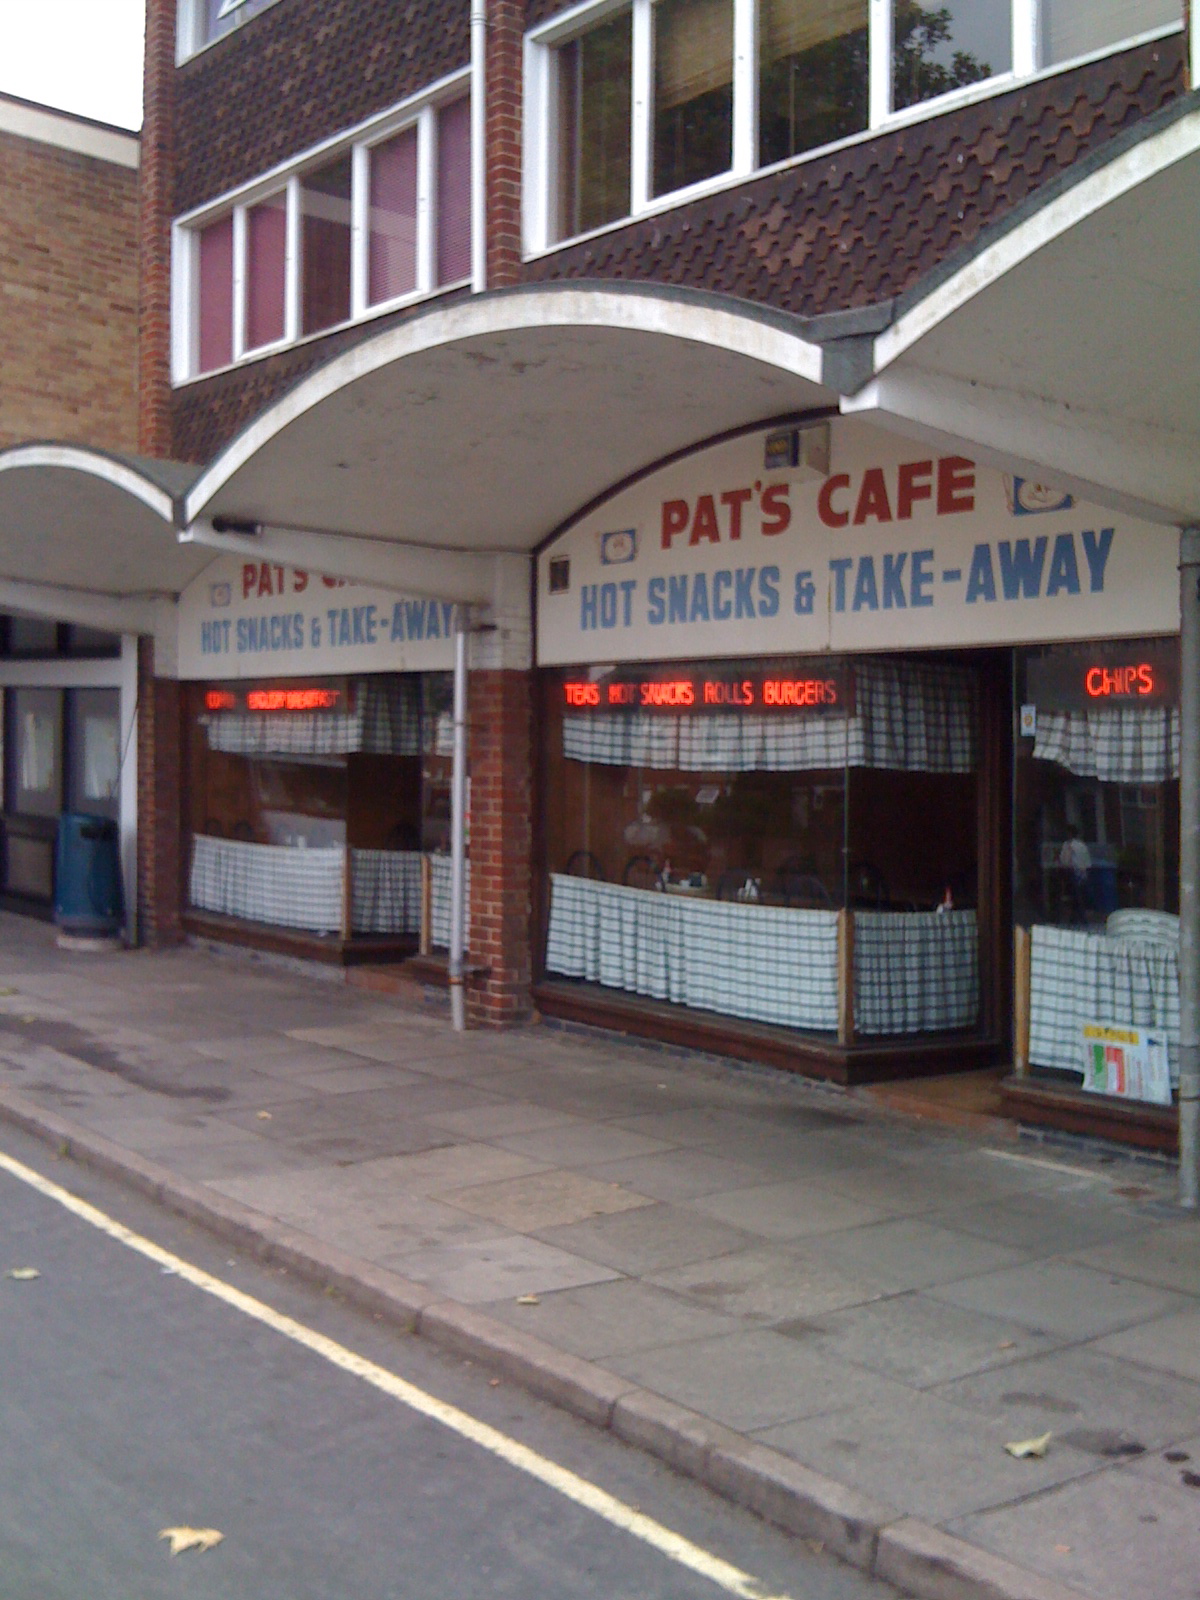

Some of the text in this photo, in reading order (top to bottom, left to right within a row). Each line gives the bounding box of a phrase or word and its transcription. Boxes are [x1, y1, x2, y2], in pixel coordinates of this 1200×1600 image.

[661, 456, 975, 549] PAT'S CAFE
[242, 562, 309, 598] PATS
[580, 527, 1115, 631] HOT SNACKS & TAKE-AWAY
[201, 601, 454, 655] HOT SNACKS & TAKE-AWAY
[564, 682, 600, 706] TEAS
[640, 681, 695, 706] SNACKS
[704, 680, 753, 705] ROLLS
[763, 679, 838, 706] BURGERS
[1084, 662, 1156, 698] CHIPS
